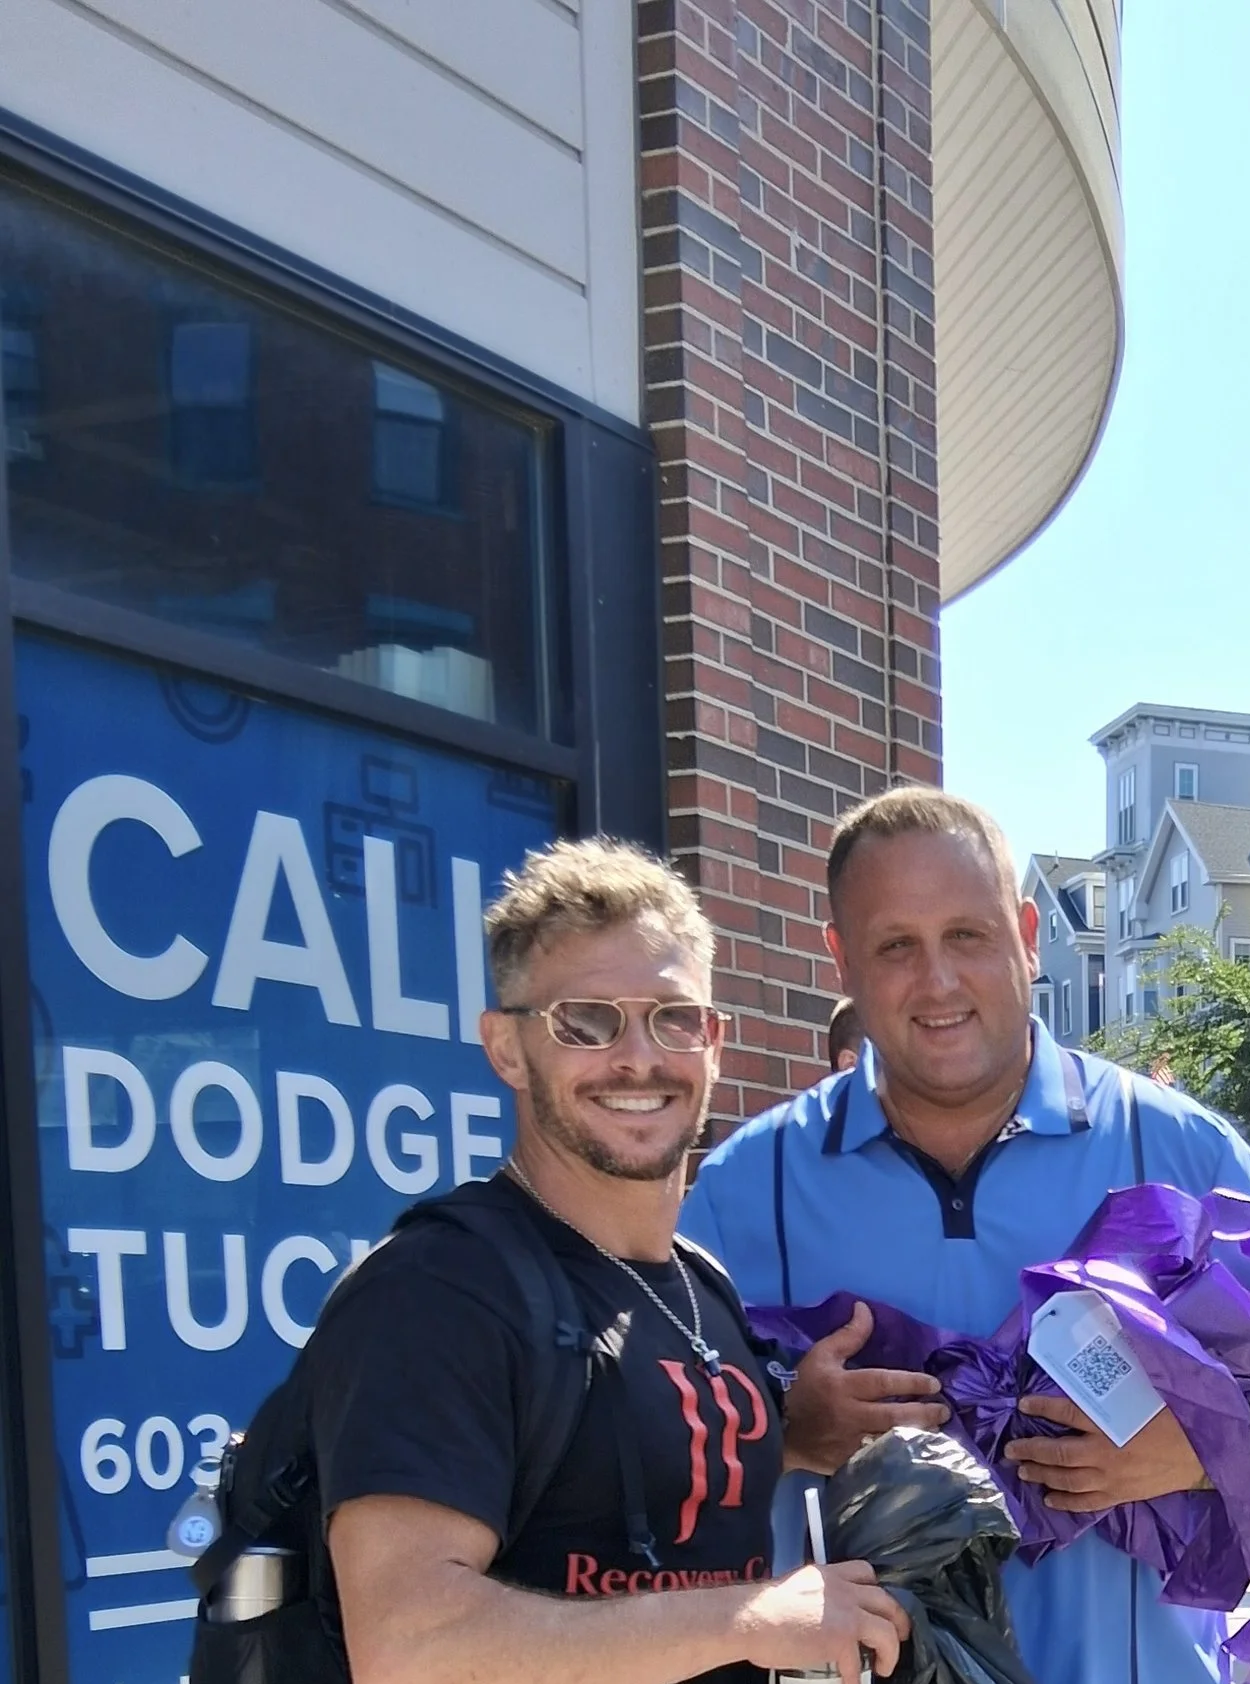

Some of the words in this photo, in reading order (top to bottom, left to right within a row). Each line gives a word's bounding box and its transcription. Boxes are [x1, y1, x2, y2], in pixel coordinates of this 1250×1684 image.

[62, 1045, 503, 1195] DODGE
[67, 1227, 371, 1351] TUC
[81, 1413, 231, 1495] 603
